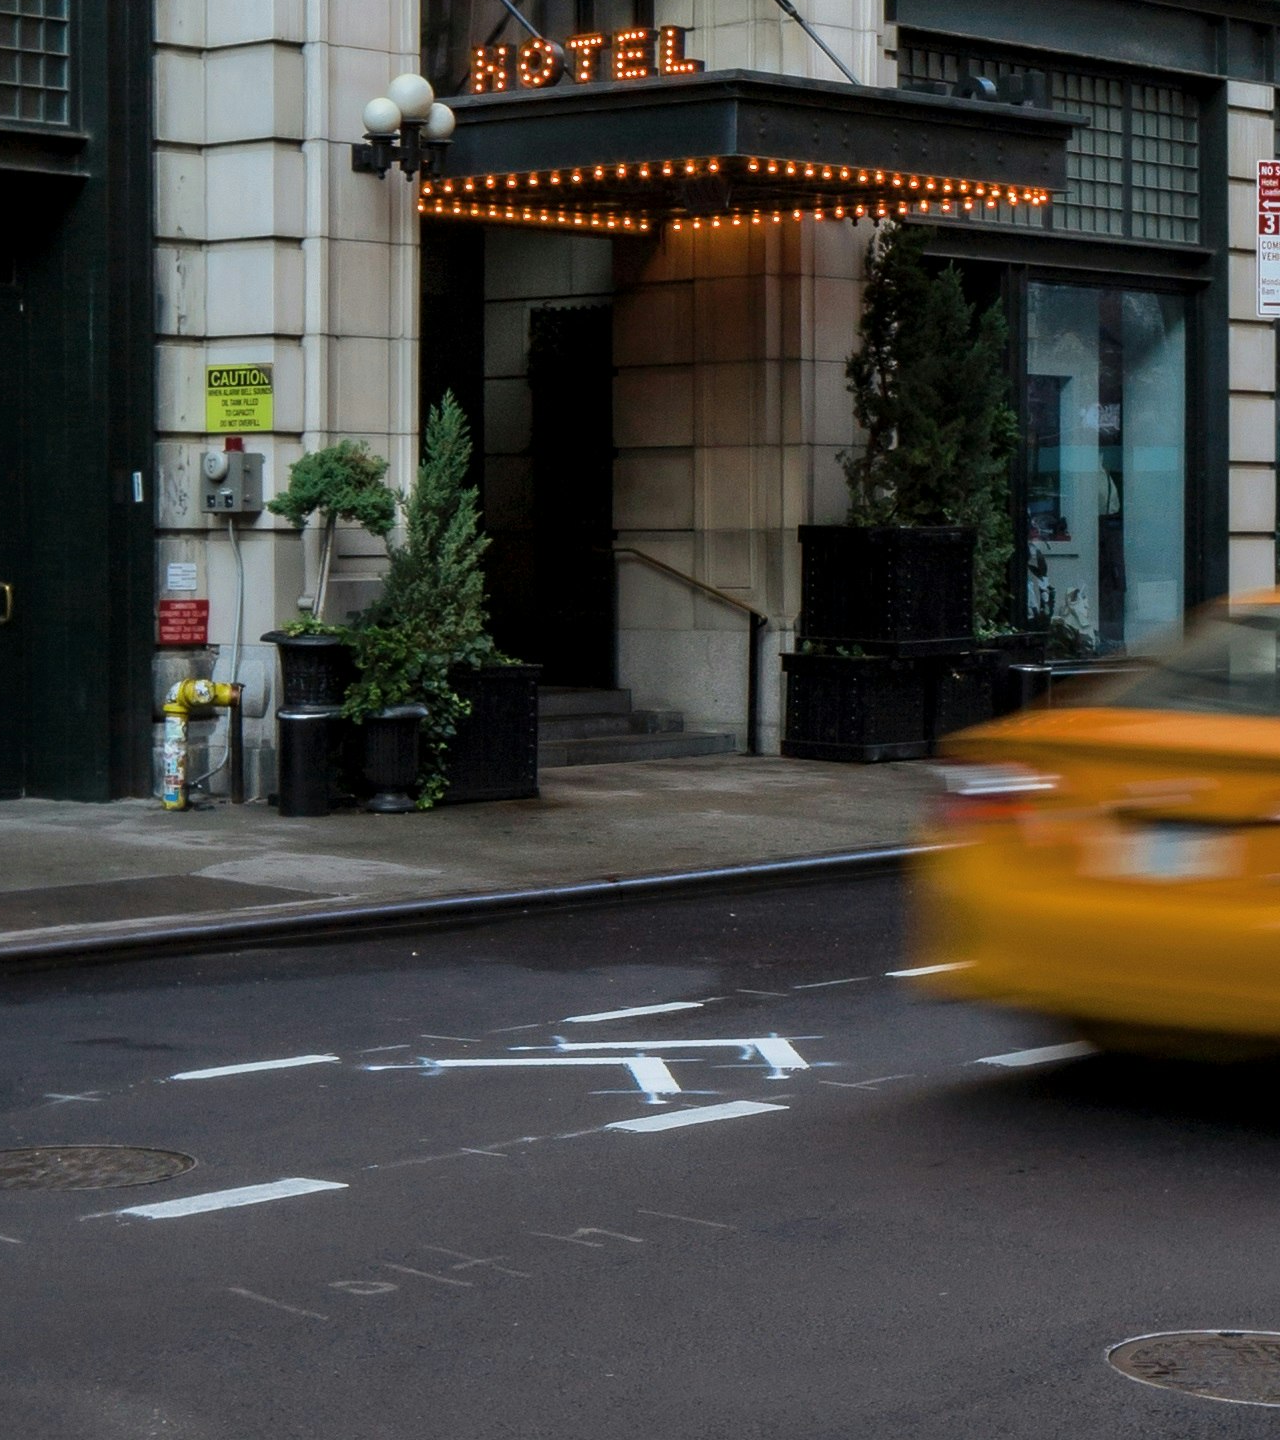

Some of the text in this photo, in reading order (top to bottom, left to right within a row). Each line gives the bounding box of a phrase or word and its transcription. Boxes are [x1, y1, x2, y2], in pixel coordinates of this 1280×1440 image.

[470, 26, 702, 94] HOTEL
[1261, 166, 1273, 175] NO
[1264, 213, 1276, 234] 3
[211, 369, 269, 386] CAUTION
